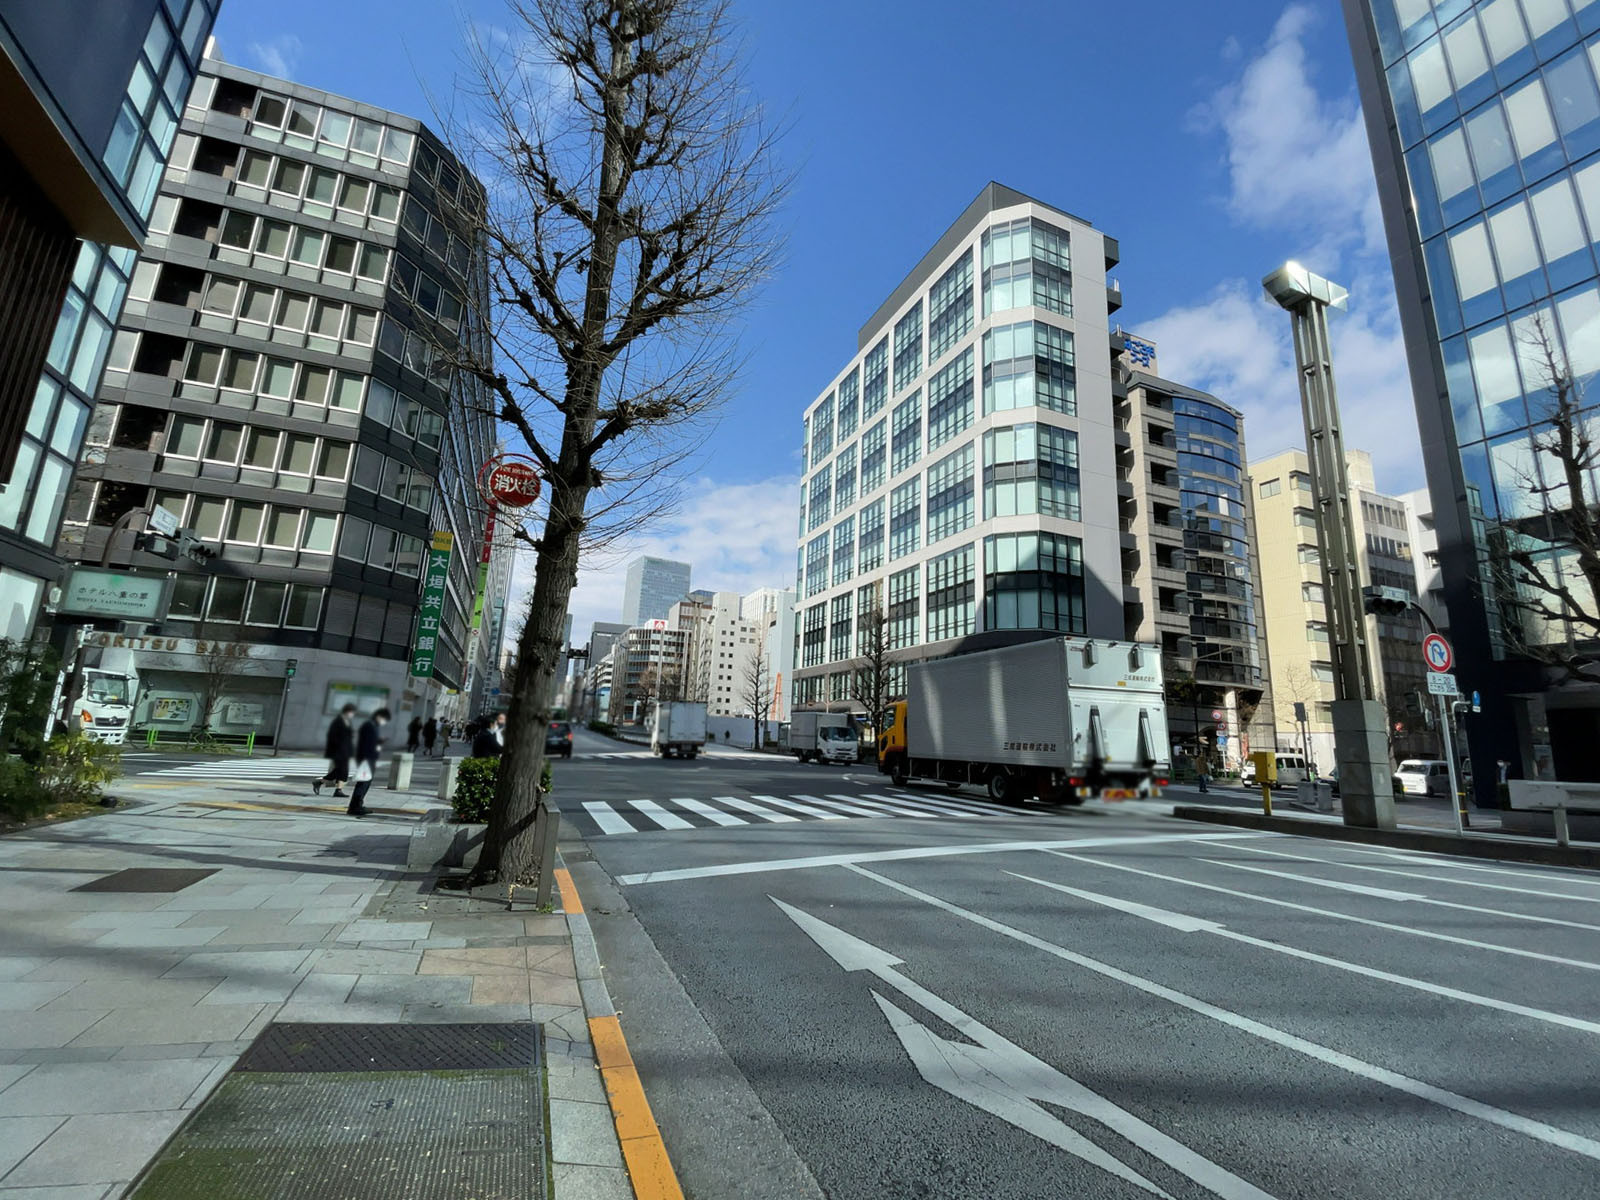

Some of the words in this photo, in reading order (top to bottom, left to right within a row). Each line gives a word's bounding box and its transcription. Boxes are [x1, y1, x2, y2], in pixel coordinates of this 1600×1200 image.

[494, 473, 539, 496] 消火栓
[415, 554, 448, 672] 大垣共立銀行
